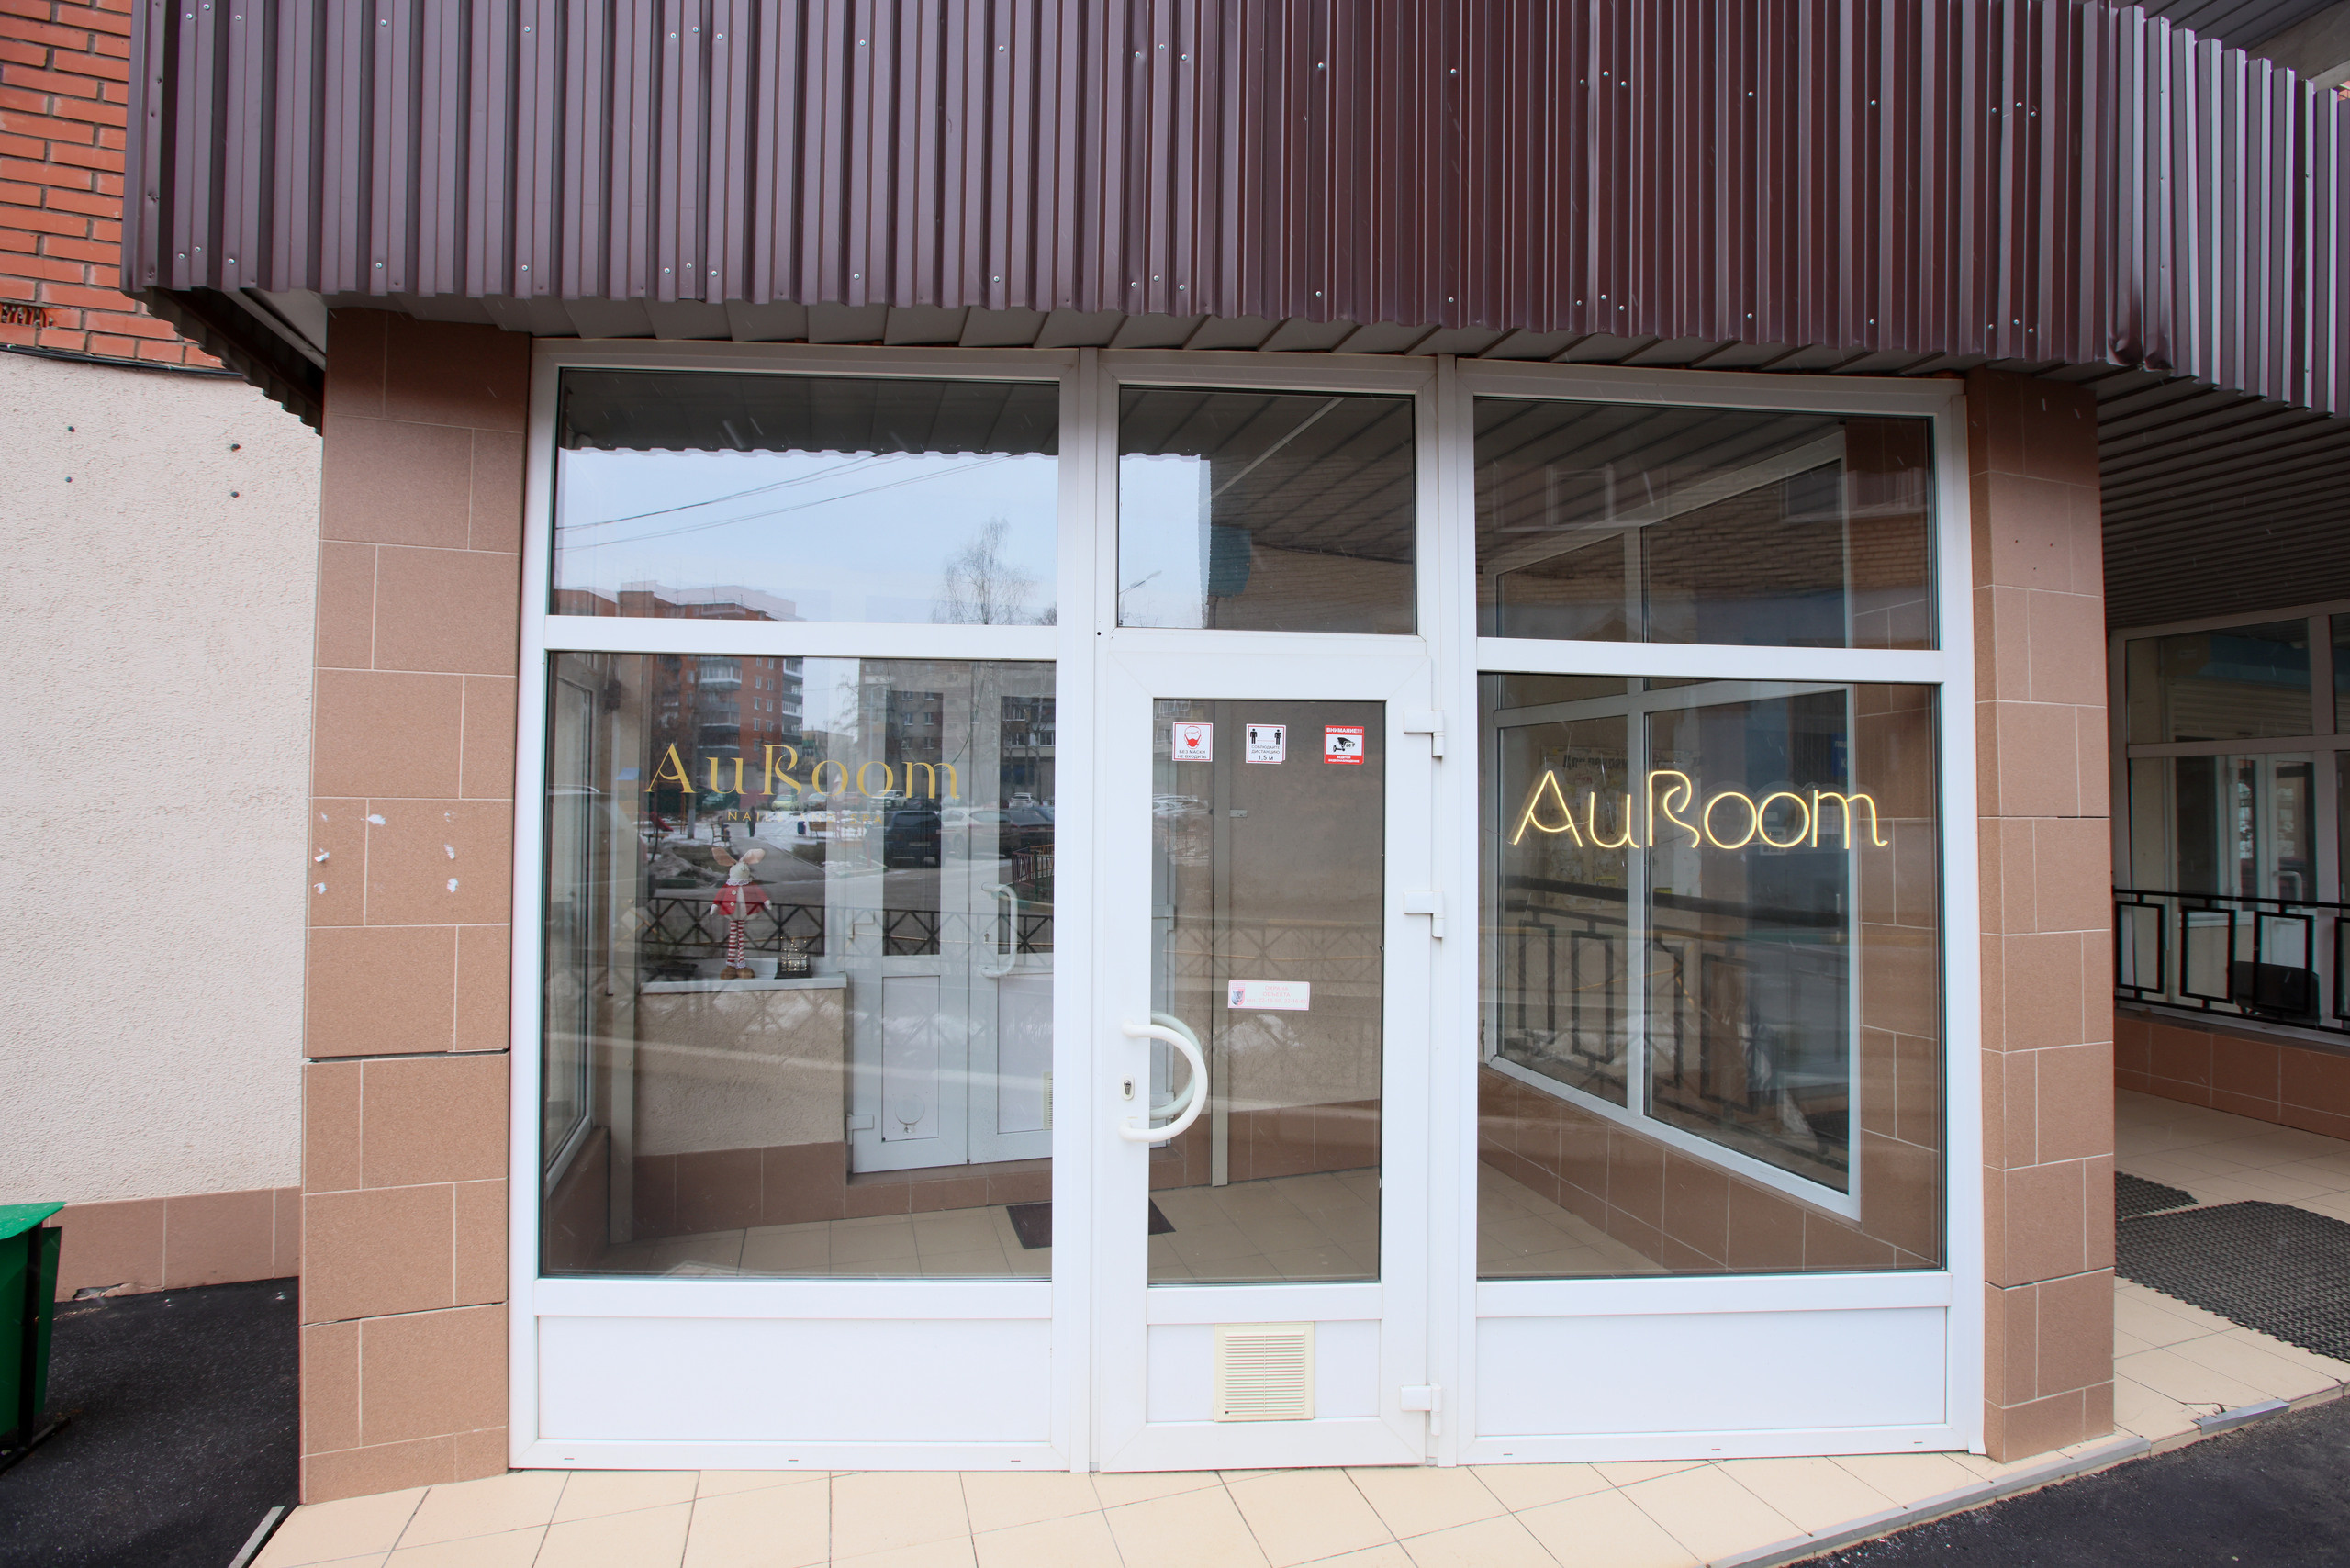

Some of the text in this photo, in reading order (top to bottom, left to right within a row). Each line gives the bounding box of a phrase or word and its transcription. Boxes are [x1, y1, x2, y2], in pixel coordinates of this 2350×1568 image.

[644, 743, 960, 800] AuRoom
[728, 812, 882, 824] NAILS AND SPA
[1513, 770, 1888, 849] AuRoom
